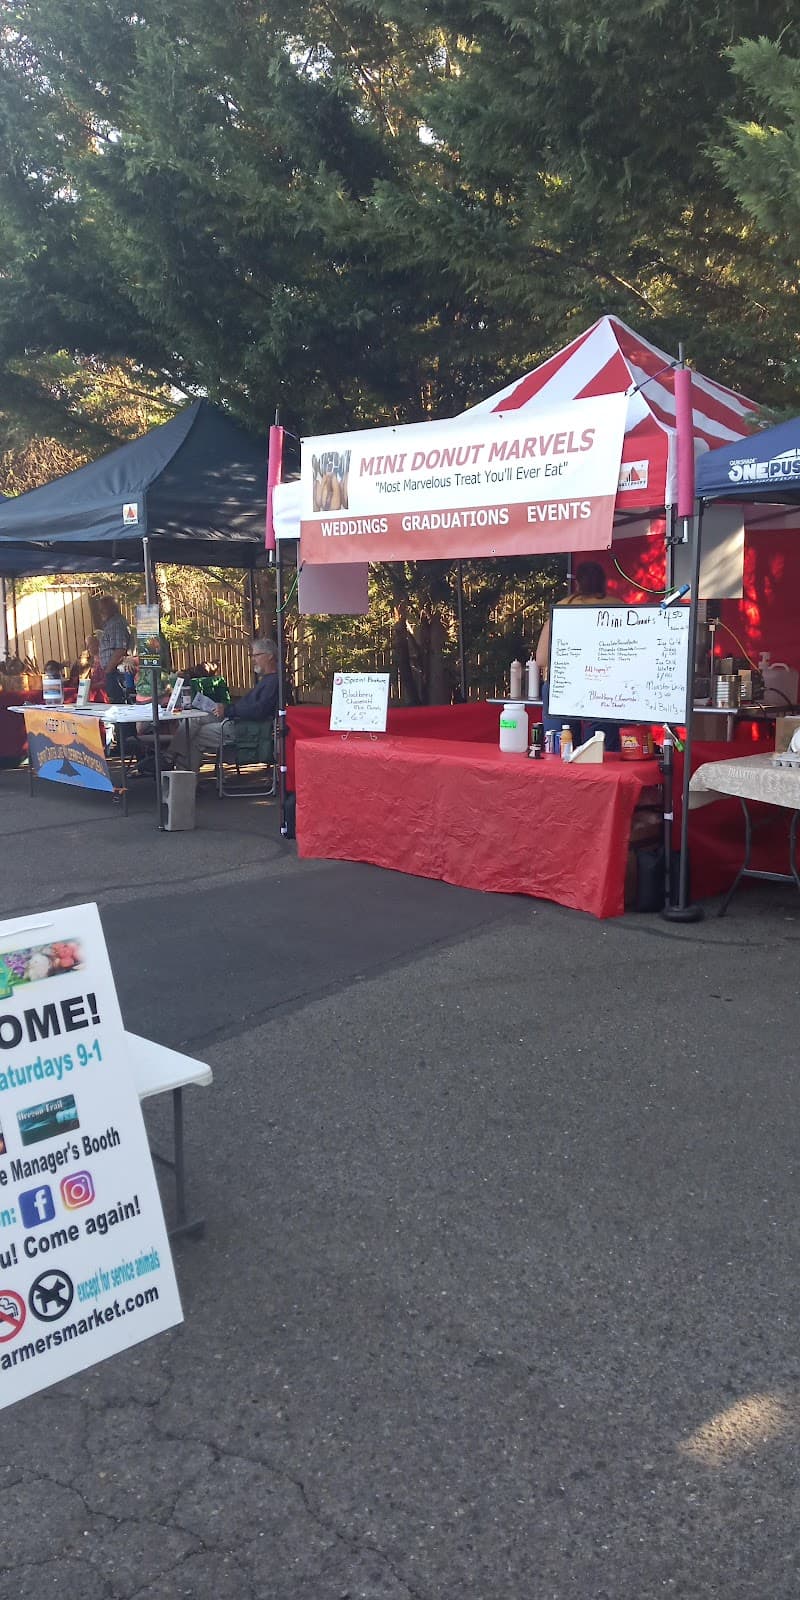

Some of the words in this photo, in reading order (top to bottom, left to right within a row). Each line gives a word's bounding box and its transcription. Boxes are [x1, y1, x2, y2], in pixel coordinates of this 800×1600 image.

[360, 453, 407, 477] MINI
[411, 443, 485, 471] DONUT
[488, 428, 595, 463] MARVELS
[376, 481, 401, 493] "Most
[403, 476, 451, 491] Marvelous
[455, 471, 481, 486] Treat
[484, 467, 512, 483] You'll
[516, 466, 541, 480] Ever
[544, 461, 568, 477] Eat"
[321, 518, 388, 537] WEDDINGS
[402, 508, 509, 532] GRADUATIONS
[527, 501, 591, 523] EVENTS
[597, 610, 622, 628] Mini
[0, 992, 101, 1050] OME!
[76, 1039, 102, 1067] 9-1
[10, 1141, 79, 1182] Manager's
[82, 1127, 121, 1156] Booth
[23, 1225, 79, 1259] Come
[85, 1195, 141, 1235] again!
[77, 1272, 101, 1302] except
[99, 1267, 110, 1292] for
[111, 1259, 135, 1288] service
[135, 1247, 160, 1277] animals
[1, 1286, 159, 1370] armersmarket.com
